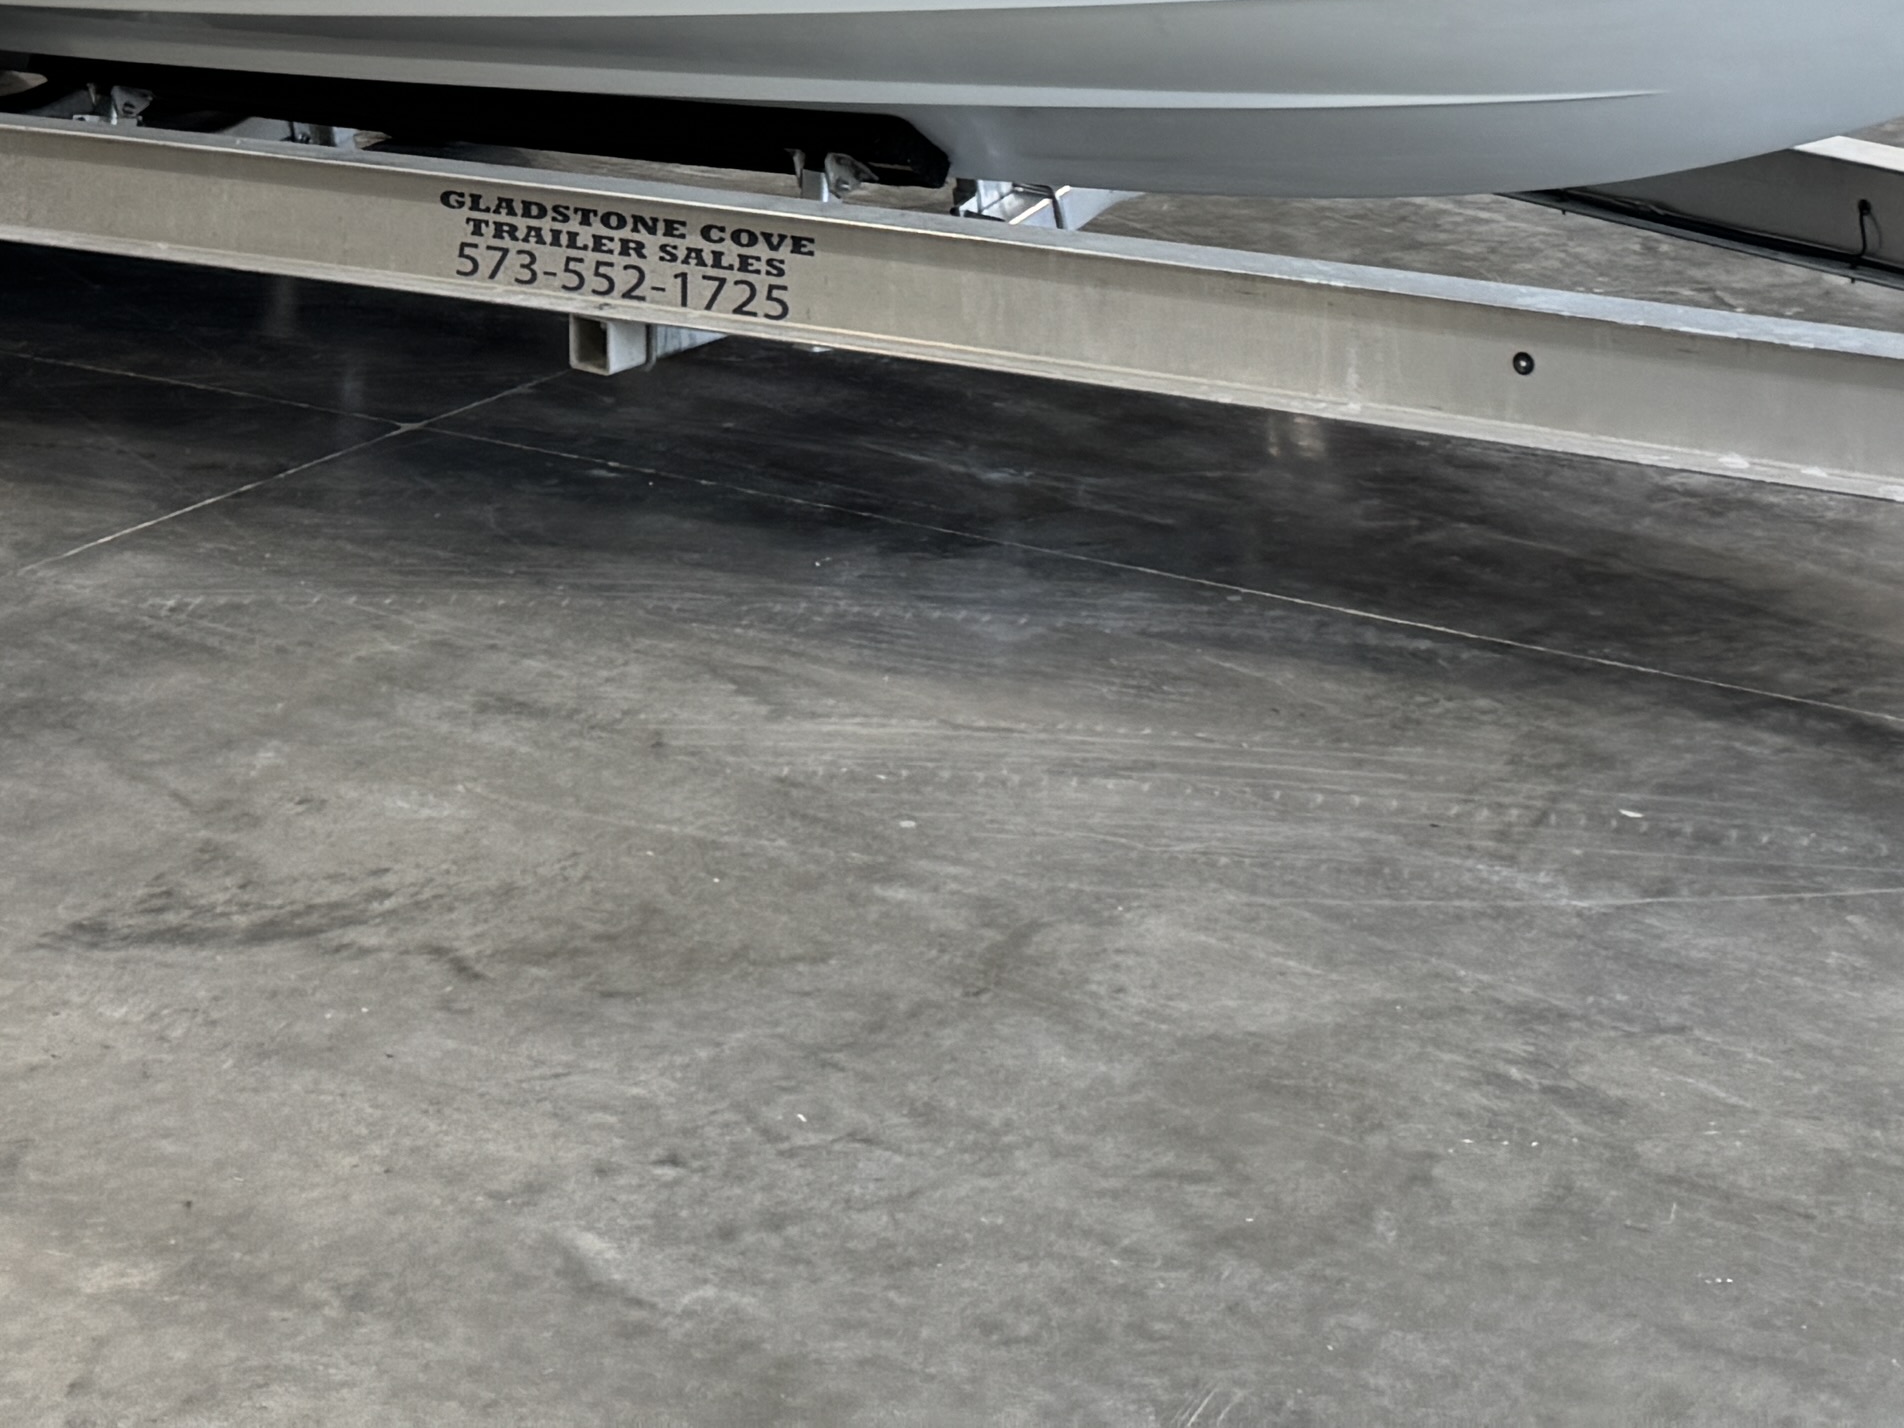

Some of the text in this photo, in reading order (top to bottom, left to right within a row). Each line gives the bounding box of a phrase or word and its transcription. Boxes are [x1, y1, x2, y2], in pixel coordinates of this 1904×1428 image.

[440, 190, 815, 257] GLADSTONE COVE
[466, 217, 787, 277] TRAILER SALES
[456, 241, 789, 321] 573-552-1725
